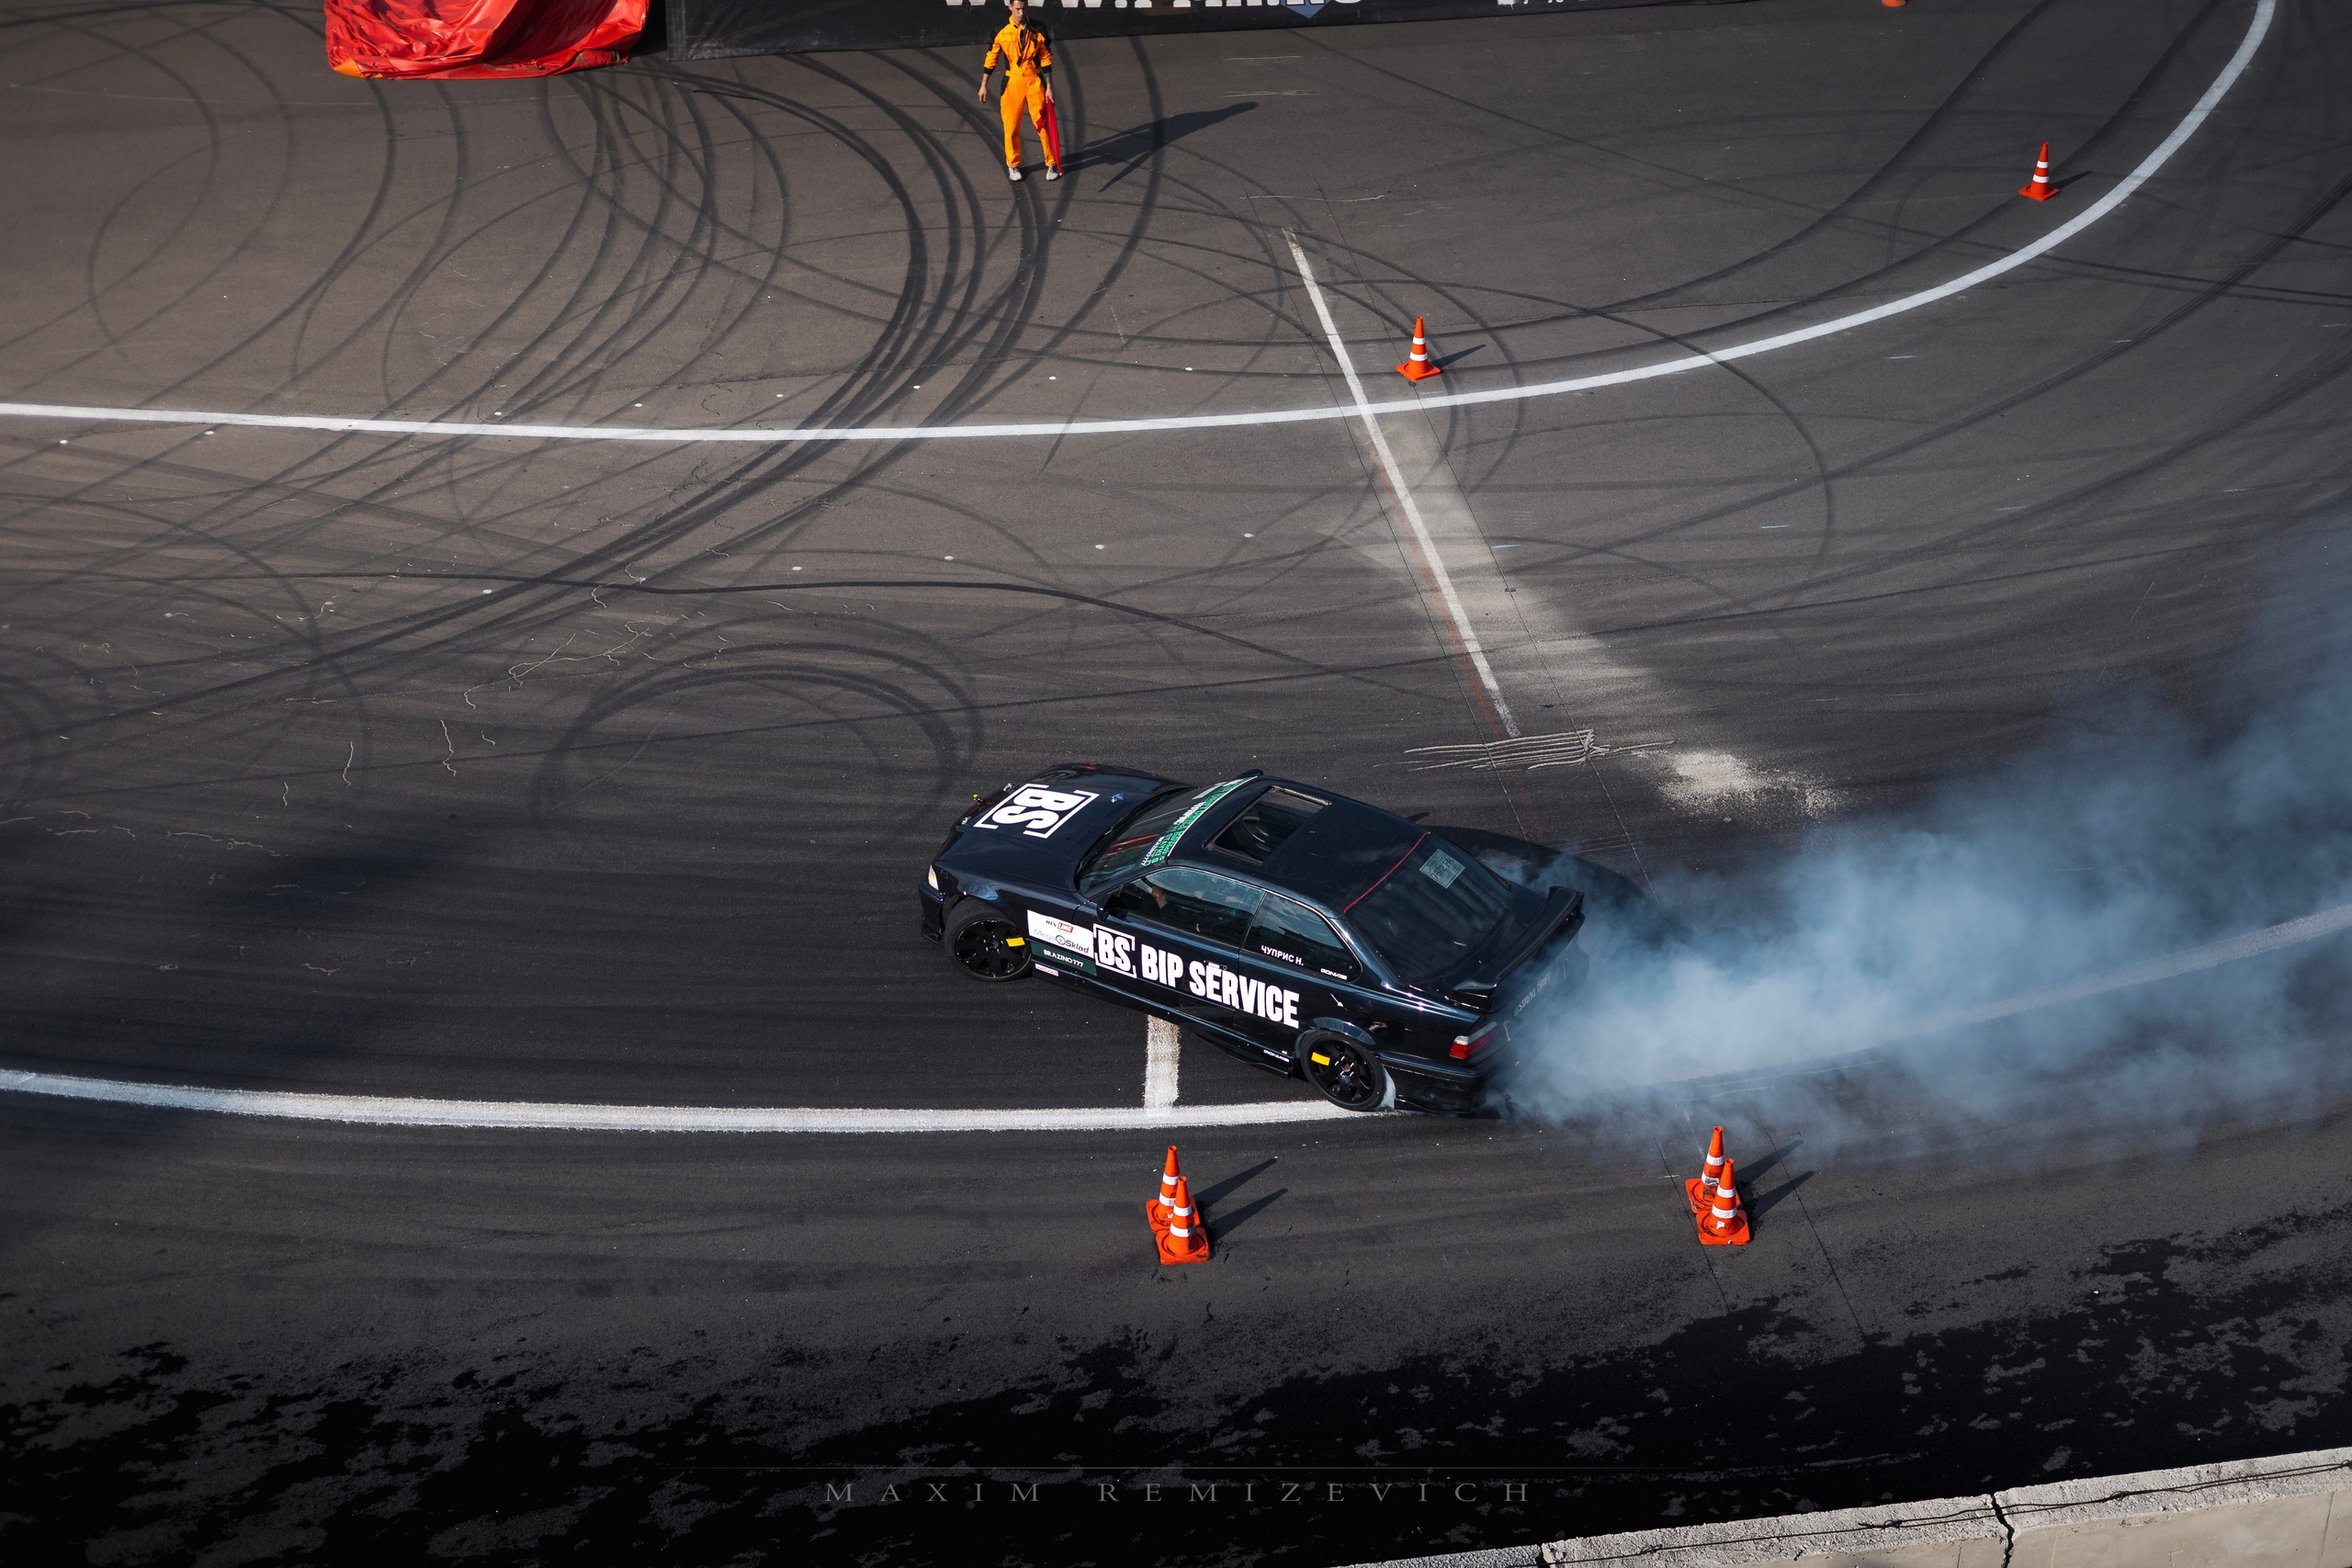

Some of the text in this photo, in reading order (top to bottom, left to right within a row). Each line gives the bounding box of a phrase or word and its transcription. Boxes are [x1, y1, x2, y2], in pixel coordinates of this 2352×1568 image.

[992, 787, 1086, 829] BS
[1261, 944, 1305, 966] ЧУПРИС Н.
[1140, 943, 1300, 1029] BIP SERVICE
